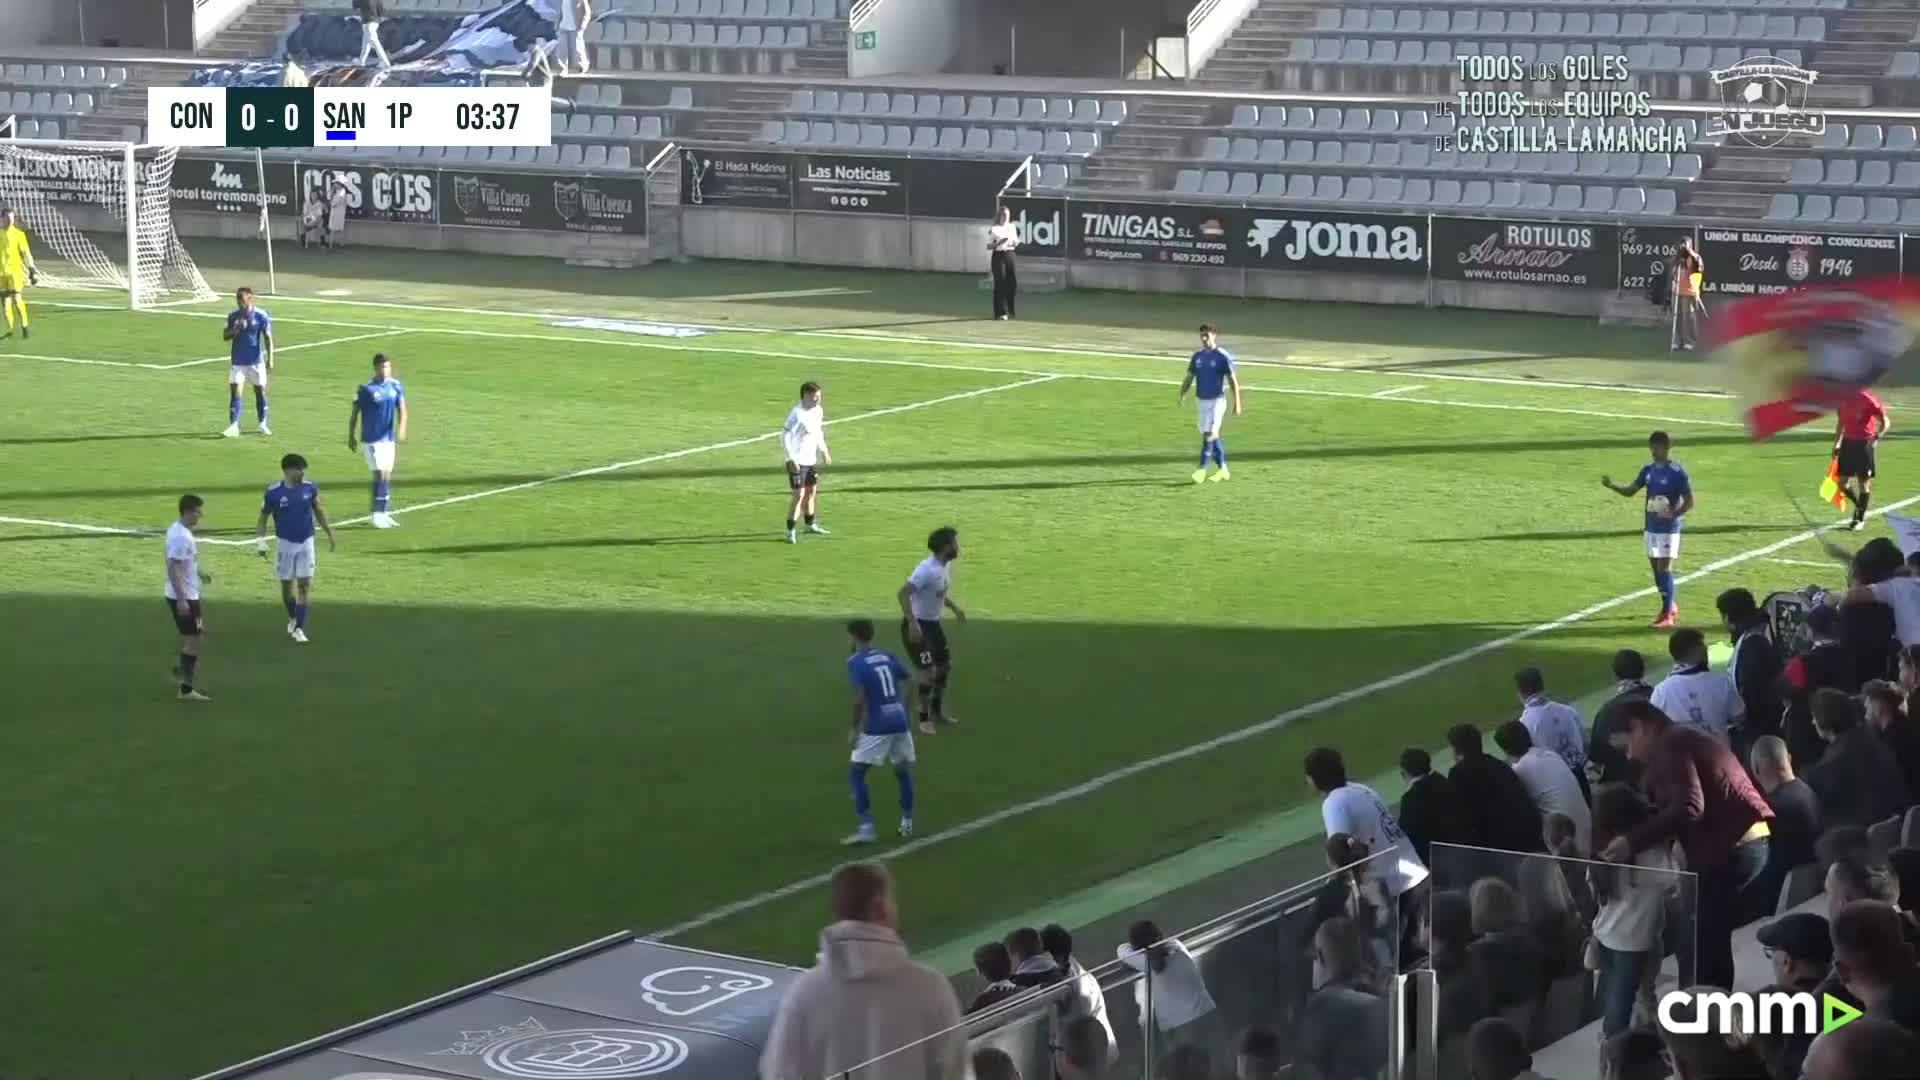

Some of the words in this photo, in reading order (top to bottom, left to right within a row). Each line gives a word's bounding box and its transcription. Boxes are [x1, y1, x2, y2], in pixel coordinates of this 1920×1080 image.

[807, 164, 831, 178] Las
[834, 165, 891, 182] Noticias
[1082, 213, 1175, 239] TINIGAS
[1285, 220, 1422, 262] Joma
[1507, 225, 1591, 248] ROTULOS
[1457, 232, 1573, 268] Arnao
[1622, 244, 1642, 255] 969
[1645, 245, 1660, 255] 24
[1740, 253, 1780, 272] Desde
[1464, 268, 1587, 284] www.rotulosarnao.es
[1623, 277, 1645, 287] 622
[920, 651, 933, 665] 23
[874, 665, 896, 697] 11
